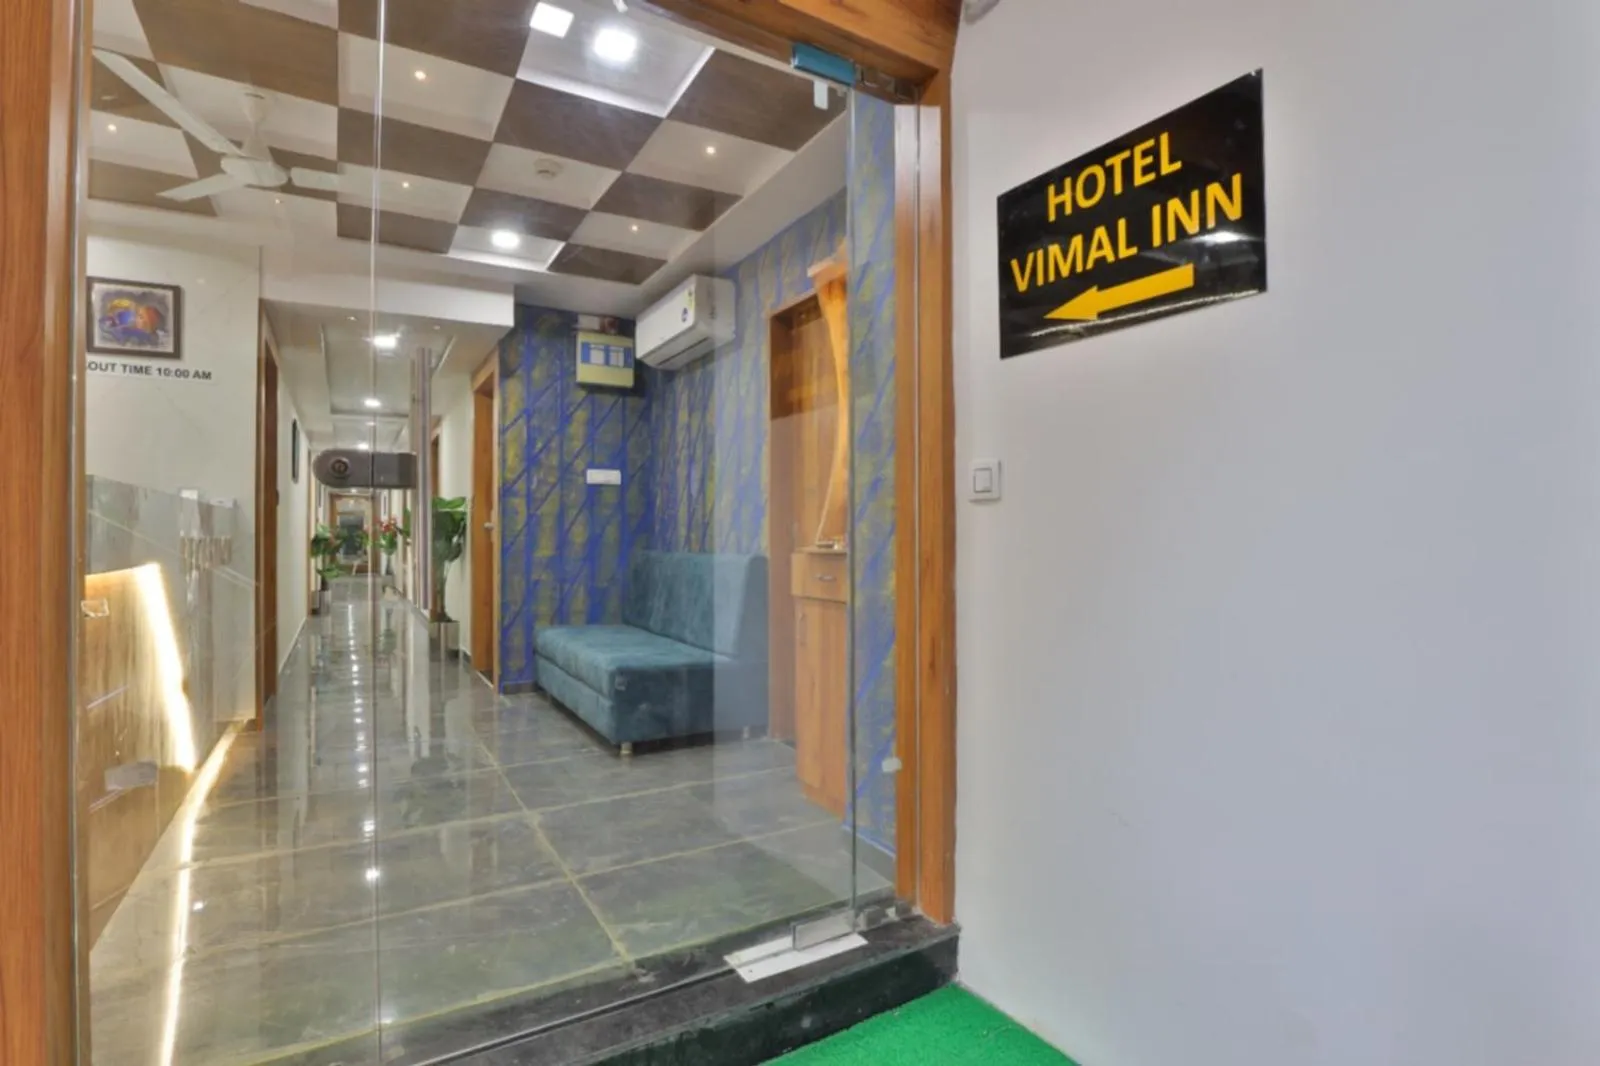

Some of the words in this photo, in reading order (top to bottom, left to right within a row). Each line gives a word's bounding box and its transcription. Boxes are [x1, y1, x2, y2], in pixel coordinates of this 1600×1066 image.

[1047, 132, 1181, 222] HOTEL
[1010, 218, 1138, 293] VIMAL
[1152, 173, 1243, 248] INN
[121, 364, 152, 376] TIME
[156, 367, 190, 379] 10:00
[192, 370, 212, 380] AM
